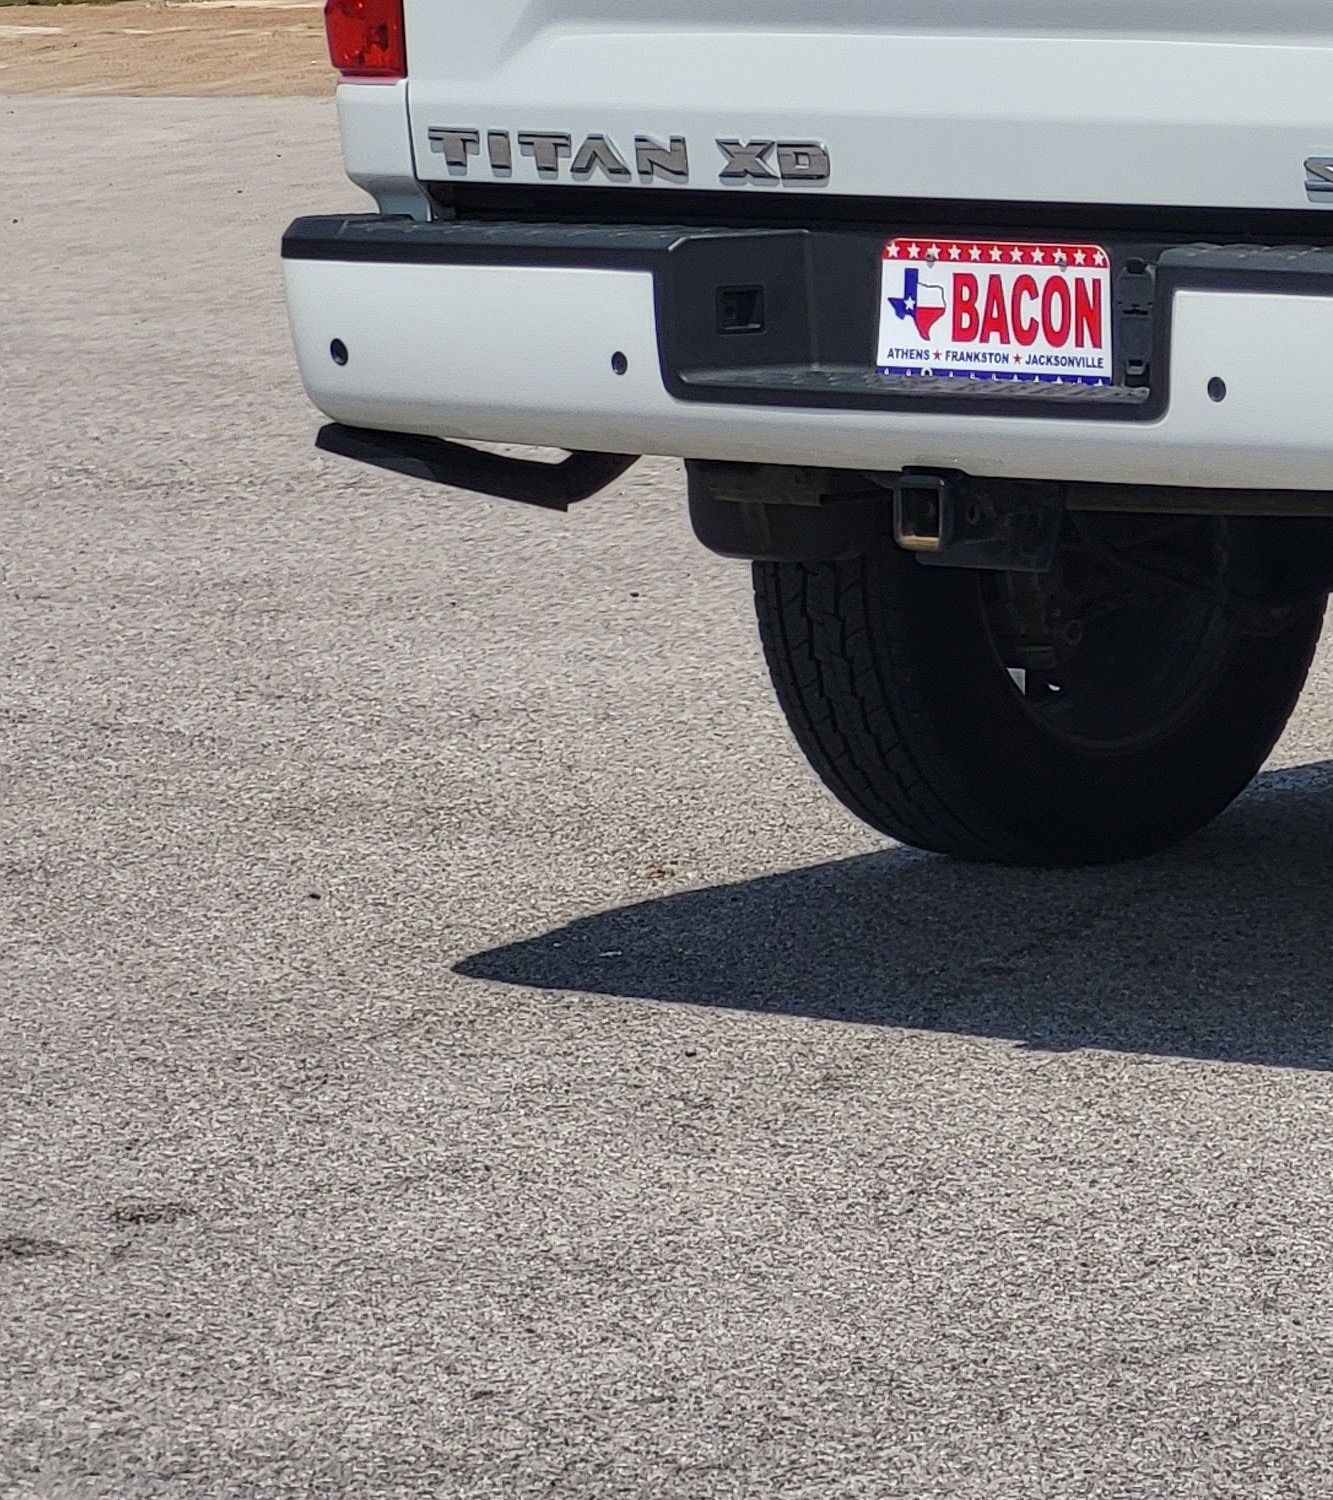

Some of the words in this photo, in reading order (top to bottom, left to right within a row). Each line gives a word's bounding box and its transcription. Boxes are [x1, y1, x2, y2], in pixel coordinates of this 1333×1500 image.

[428, 126, 688, 181] TITAN
[716, 137, 830, 185] XD
[951, 272, 1103, 349] BACON
[886, 347, 931, 361] ATHENS
[944, 349, 1010, 365] FRANKSTON
[1024, 353, 1105, 369] JACKSONVILLE
